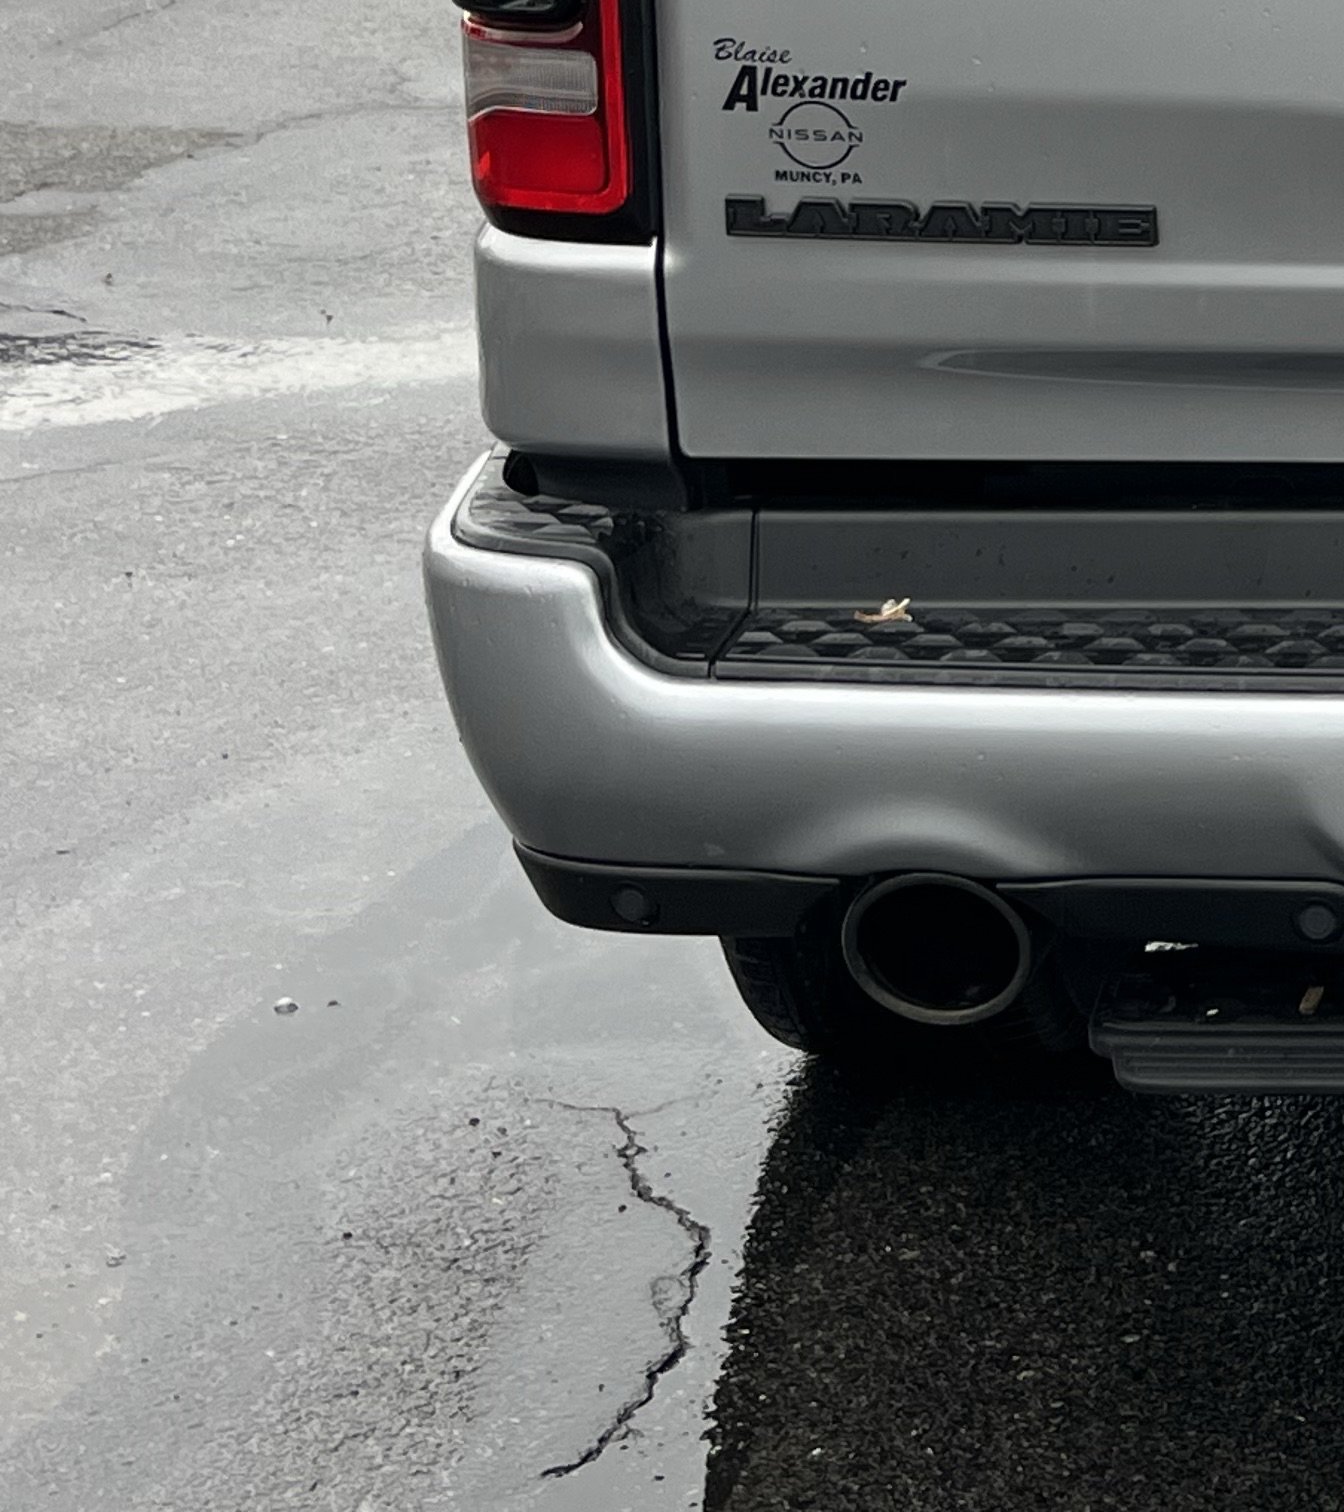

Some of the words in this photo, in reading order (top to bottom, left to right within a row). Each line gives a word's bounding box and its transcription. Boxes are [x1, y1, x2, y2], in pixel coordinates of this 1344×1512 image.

[713, 38, 792, 64] Blaise
[722, 65, 907, 112] Alexander
[768, 128, 863, 143] NISSAN
[775, 170, 837, 186] MUNCY,
[841, 172, 863, 185] PA
[724, 193, 1160, 247] LARAMIE
